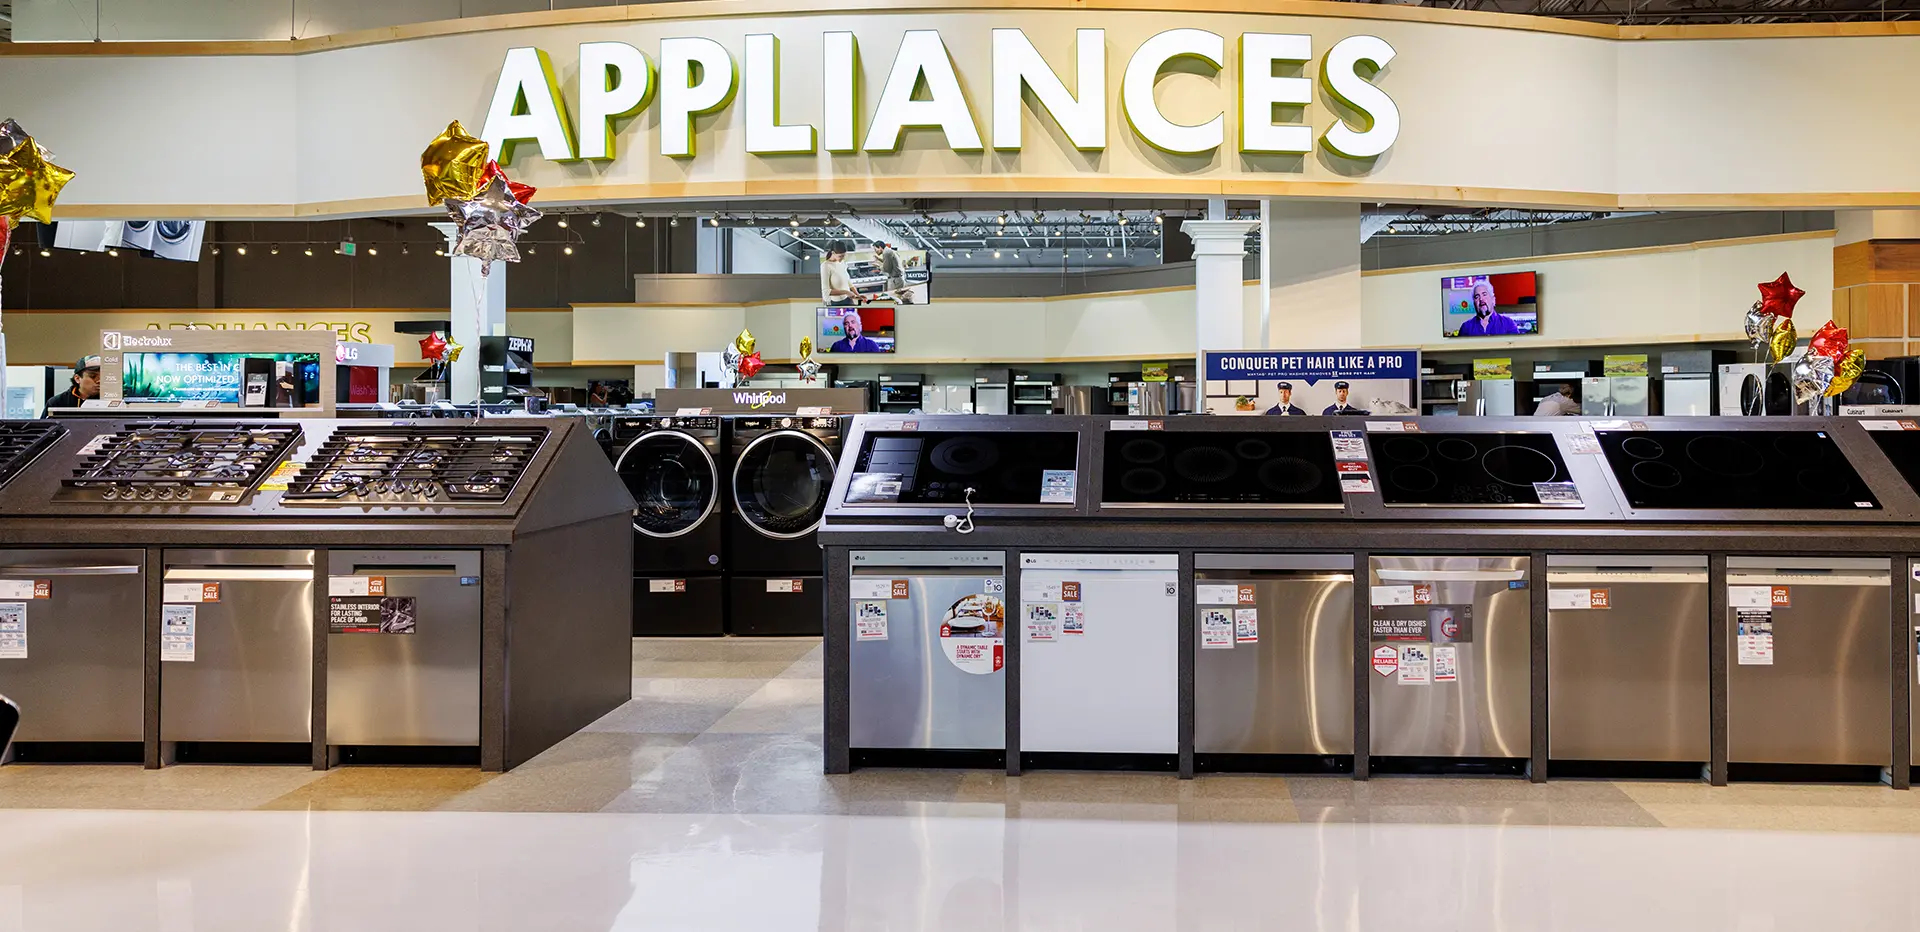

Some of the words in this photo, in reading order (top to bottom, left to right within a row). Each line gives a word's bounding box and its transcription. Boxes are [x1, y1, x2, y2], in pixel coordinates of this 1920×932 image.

[481, 27, 1400, 161] APPLIANCES
[345, 348, 358, 359] LG
[176, 364, 194, 372] THE
[195, 363, 219, 372] BEST
[220, 363, 231, 372] IN
[1220, 356, 1278, 371] CONQUER
[1281, 356, 1303, 370] PET
[1307, 356, 1335, 370] HAIR
[1338, 356, 1364, 369] LIKE
[1367, 356, 1375, 369] A
[1378, 356, 1403, 369] PRO
[157, 375, 181, 384] NOW
[183, 375, 235, 384] OPTIMIZED
[732, 391, 787, 408] Whirlpool
[34, 589, 49, 597] SALE
[369, 585, 384, 593] SALE
[203, 591, 218, 600] SALE
[1063, 590, 1078, 598] SALE
[1239, 594, 1254, 602] SALE
[1591, 598, 1607, 606] SALE
[1772, 595, 1788, 603] SALE
[330, 603, 357, 611] STAINLESS
[357, 603, 380, 611] INTERIOR
